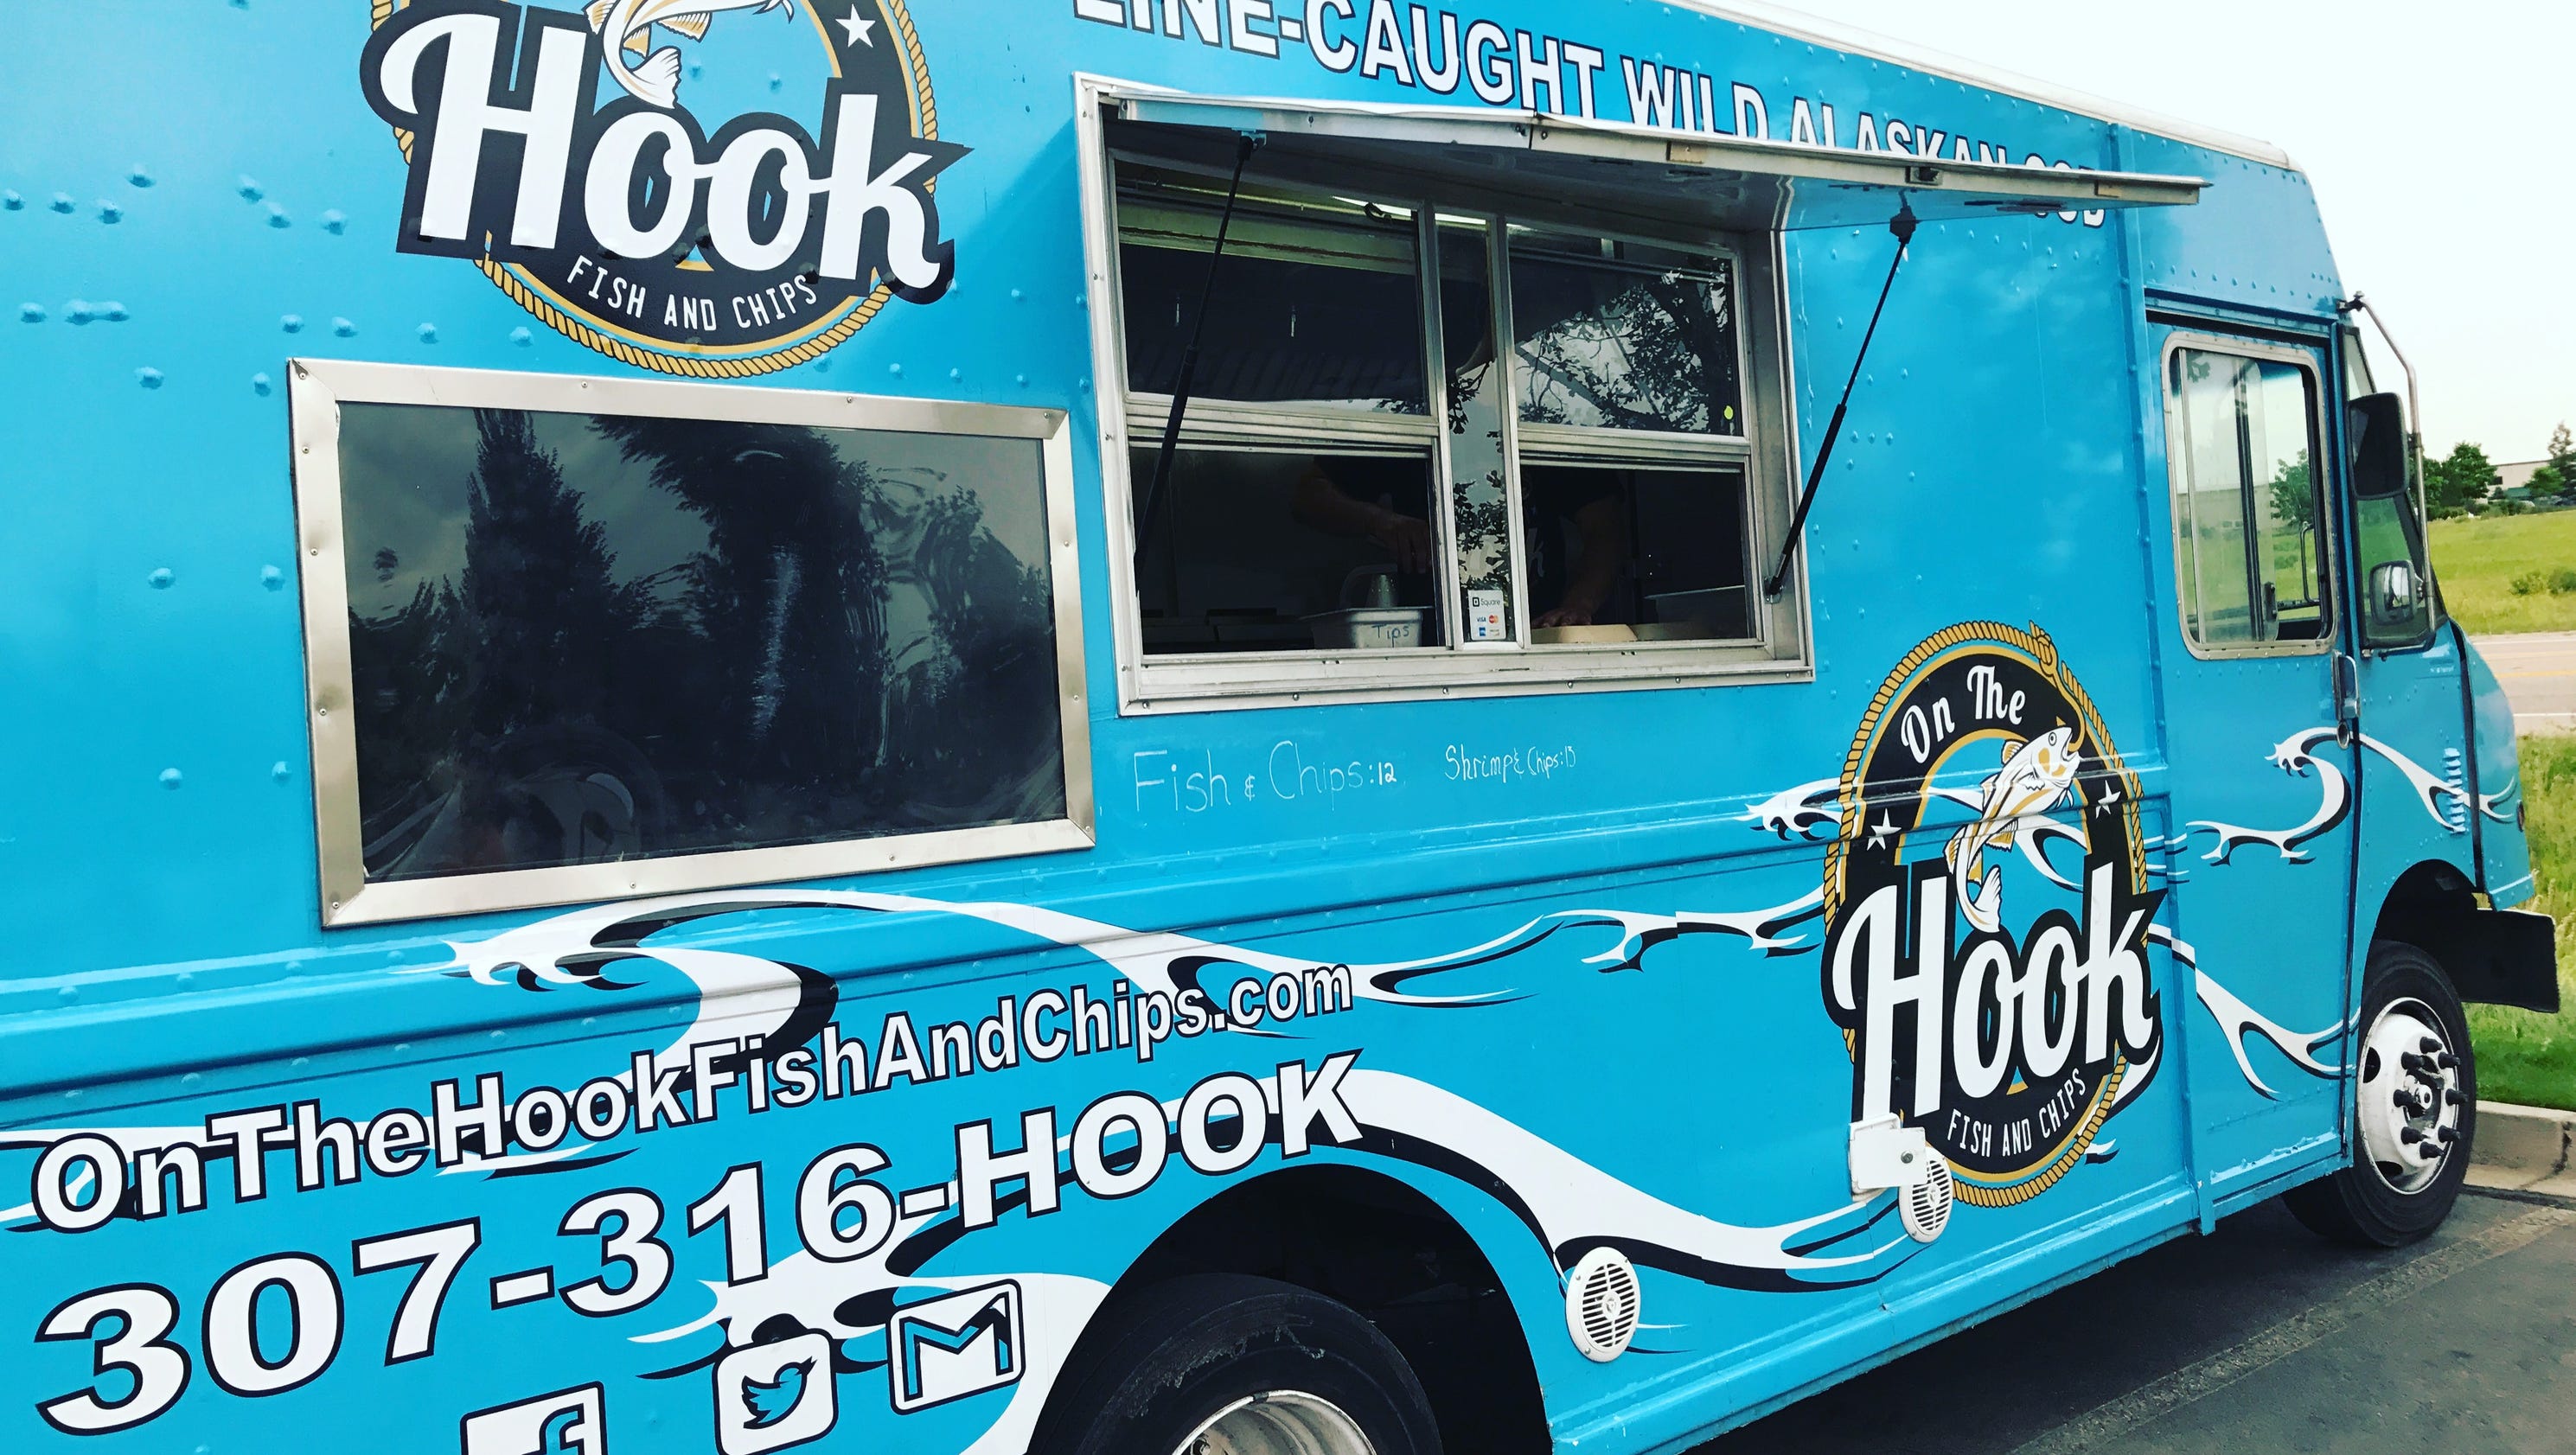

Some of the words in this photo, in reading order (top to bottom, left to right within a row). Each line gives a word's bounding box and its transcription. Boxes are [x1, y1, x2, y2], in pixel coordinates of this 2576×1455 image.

[1073, 0, 1604, 119] NE-CAUGHT
[1620, 54, 1770, 141] WILD
[380, 12, 941, 290] Hook
[566, 254, 647, 319] FISH
[663, 293, 717, 331] AND
[732, 274, 817, 329] CHIPS
[1371, 623, 1410, 648] Tips
[1901, 705, 1955, 763] On
[1966, 665, 2026, 725] The
[1134, 749, 1231, 813] Fish
[1832, 862, 2153, 1122] Hook
[30, 963, 1352, 1234] OnTheHookFishAndChips.com
[1947, 1108, 1992, 1158] FISH
[2002, 1118, 2032, 1157] AND
[2038, 1068, 2087, 1139] CHIPS
[35, 1048, 1365, 1437] 307-316-HOOK
